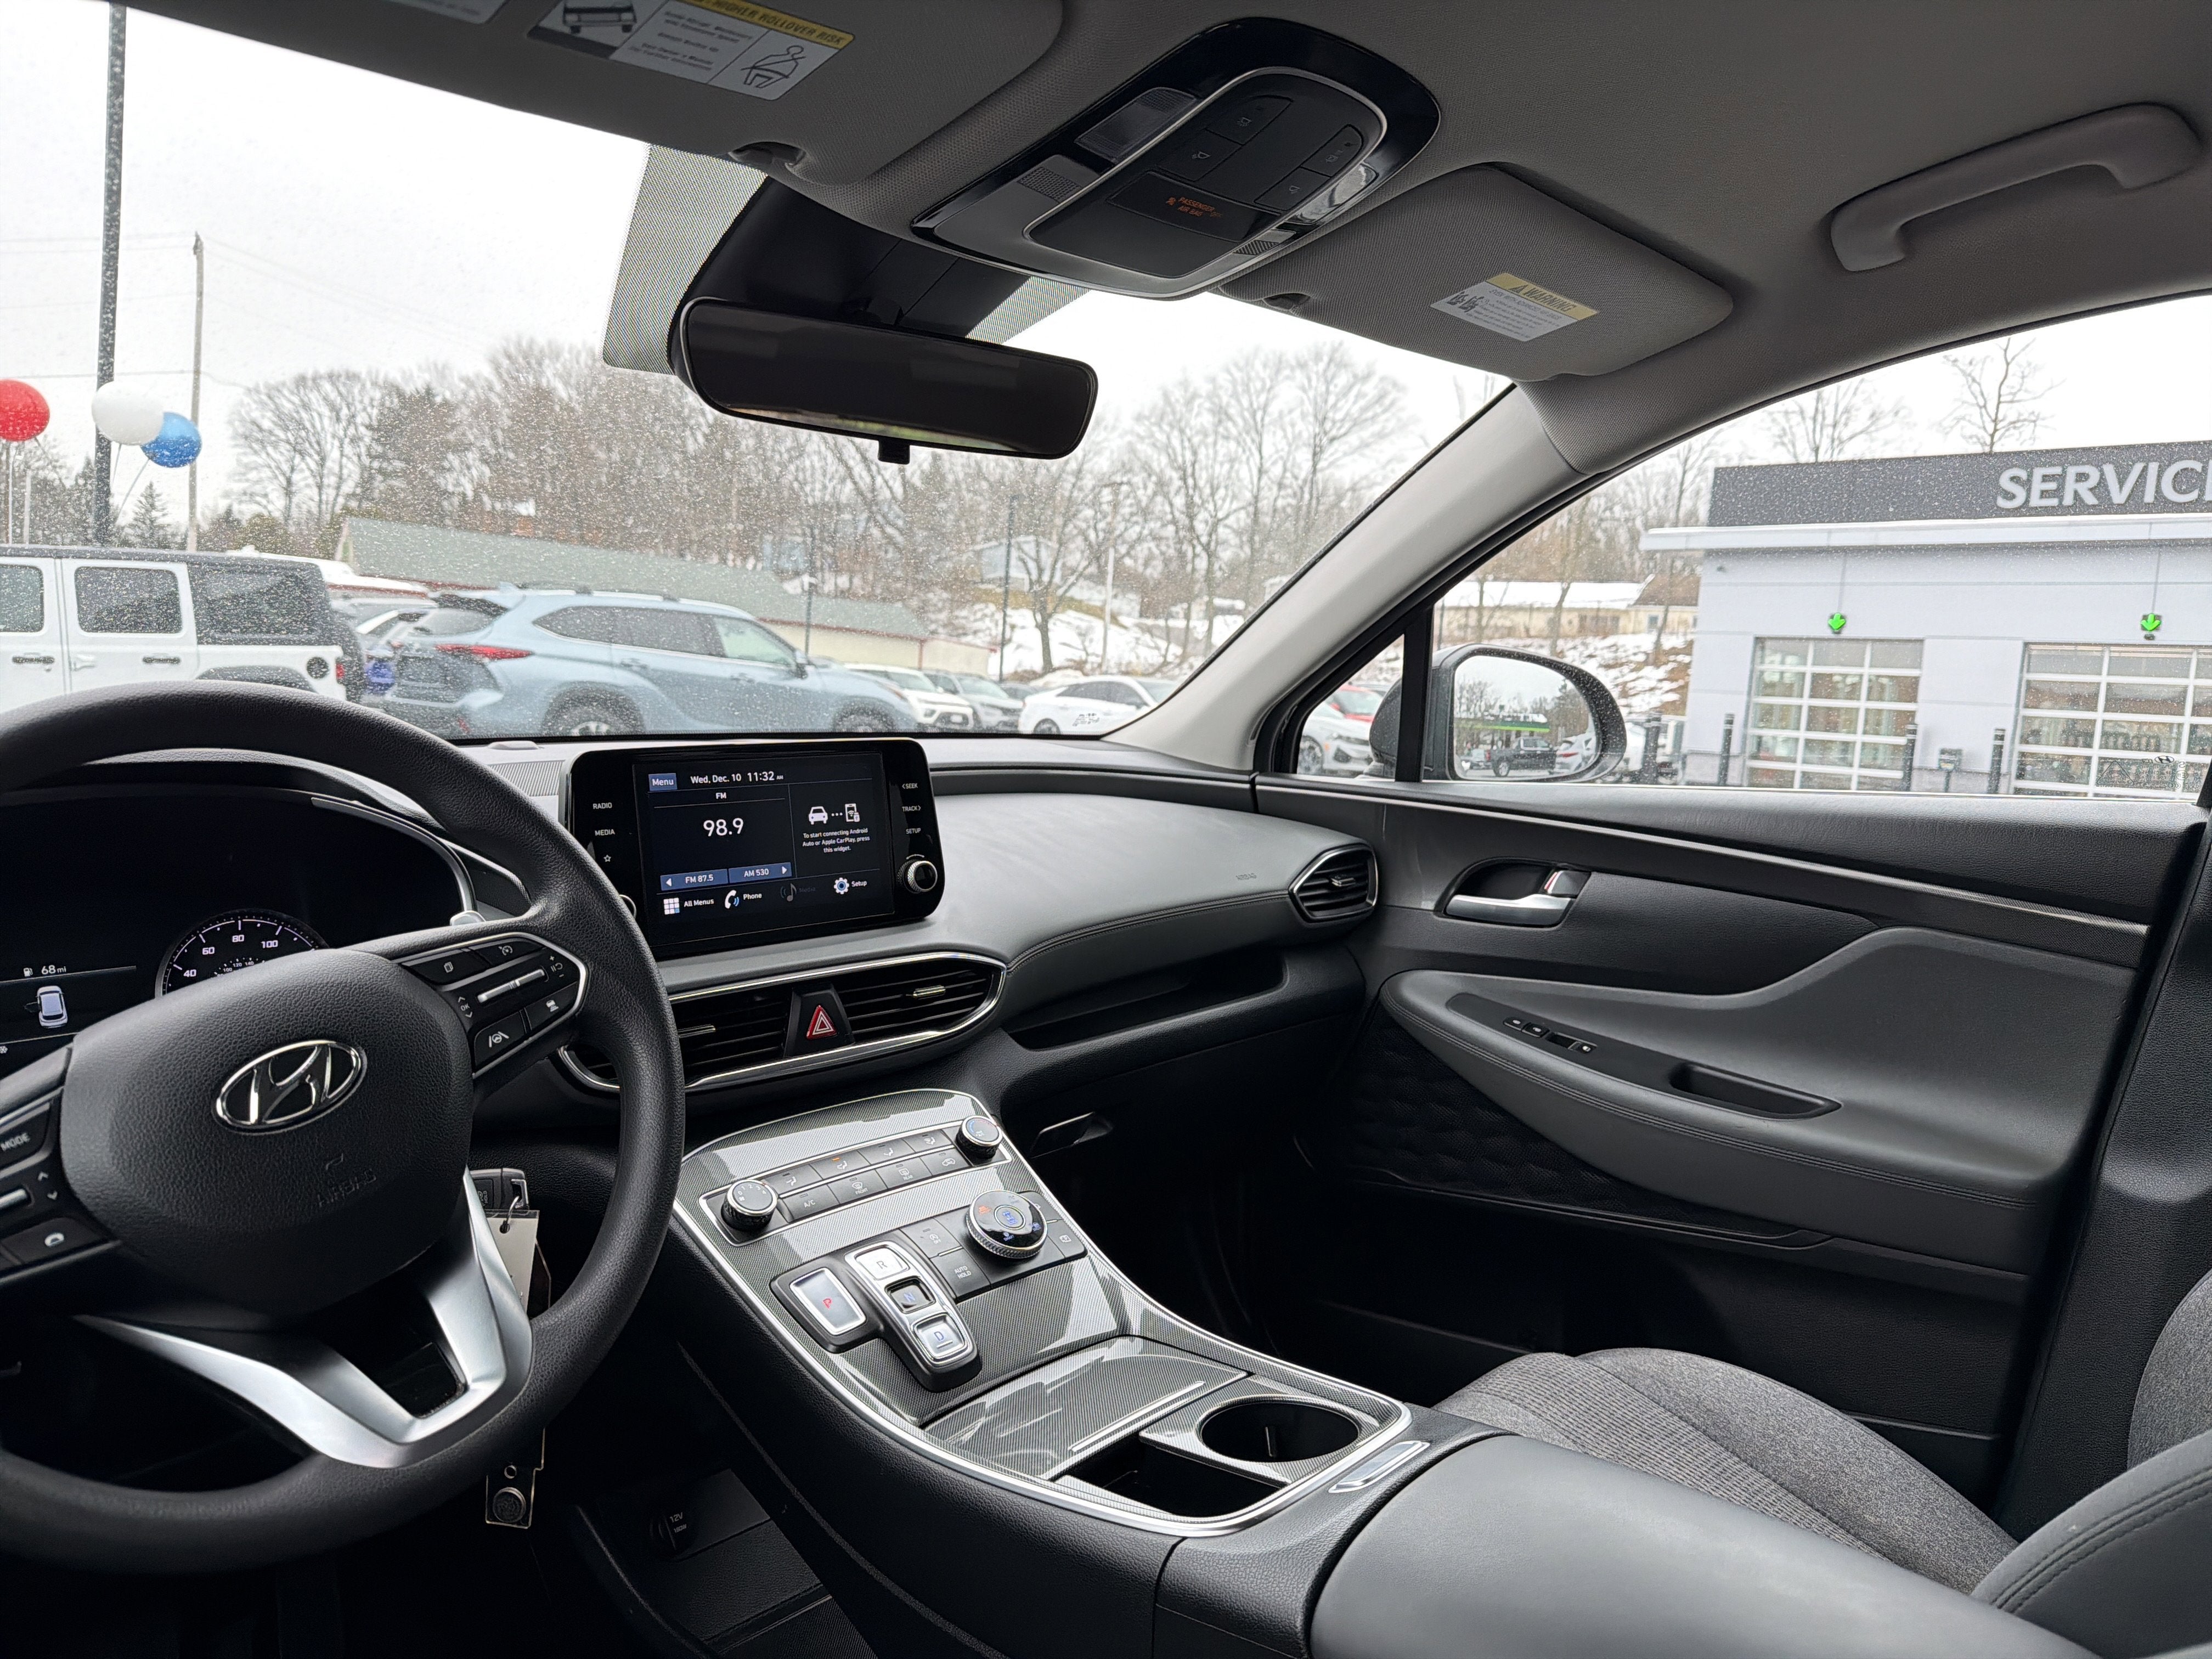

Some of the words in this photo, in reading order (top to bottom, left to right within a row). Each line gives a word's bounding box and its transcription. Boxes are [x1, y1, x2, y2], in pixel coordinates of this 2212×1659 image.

[759, 12, 815, 36] ROLLOVER
[817, 31, 844, 44] RISK
[1178, 197, 1215, 212] PASSENGER
[1523, 287, 1577, 312] WARNING
[1996, 459, 2212, 509] SERVIC
[712, 775, 730, 783] Dec.
[732, 773, 741, 782] 10
[747, 771, 775, 782] 11:32
[652, 778, 674, 786] Menu
[703, 817, 744, 837] 98.9
[743, 870, 754, 878] AM
[756, 868, 769, 876] 530
[698, 874, 714, 882] 87.5
[693, 898, 714, 906] Menus
[232, 934, 245, 943] 80
[261, 940, 278, 949] 100
[202, 946, 215, 955] 60
[41, 964, 56, 975] 68
[183, 969, 197, 977] 40
[460, 1003, 470, 1011] OK
[1, 1132, 30, 1152] MODE
[804, 1199, 816, 1208] A/C
[876, 1260, 888, 1269] R
[954, 1266, 968, 1274] AUTO
[957, 1270, 972, 1279] HOLD
[904, 1292, 916, 1302] N
[934, 1330, 944, 1342] D
[669, 1511, 683, 1523] 12V
